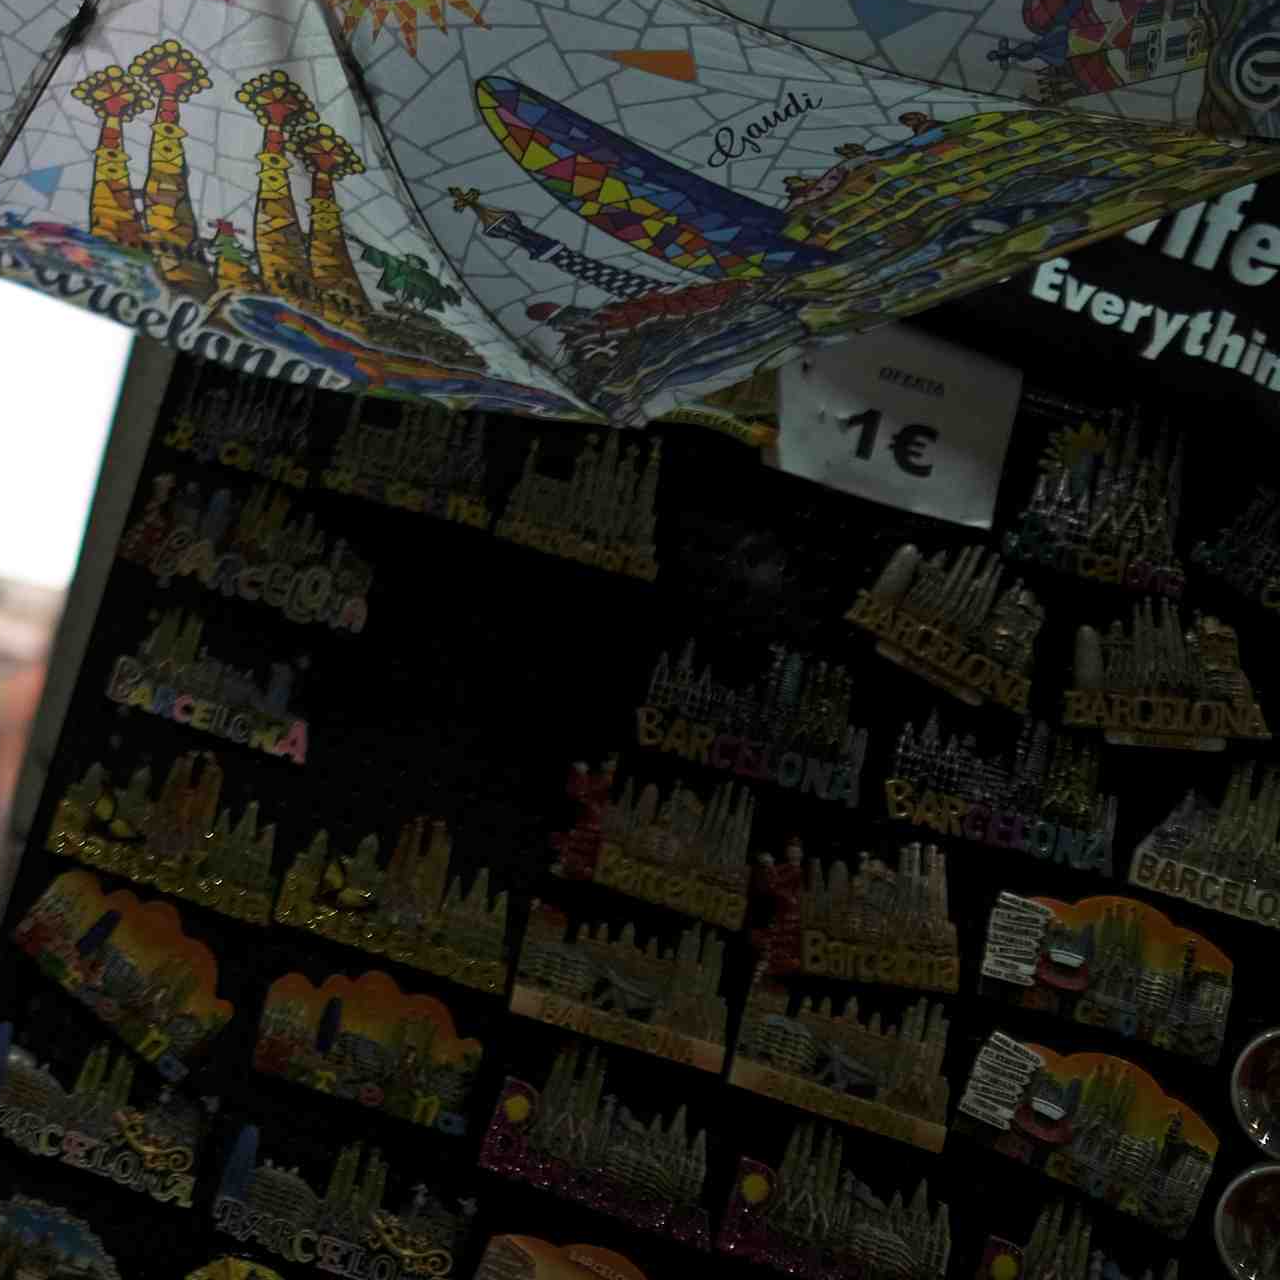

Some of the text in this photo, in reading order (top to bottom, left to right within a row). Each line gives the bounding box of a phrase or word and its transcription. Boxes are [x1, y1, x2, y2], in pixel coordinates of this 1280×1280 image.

[708, 92, 823, 167] Gaudi
[1123, 183, 1280, 287] ife
[848, 408, 939, 477] 1€
[1064, 687, 1271, 740] BARCELONA
[804, 931, 956, 990] Barcelona
